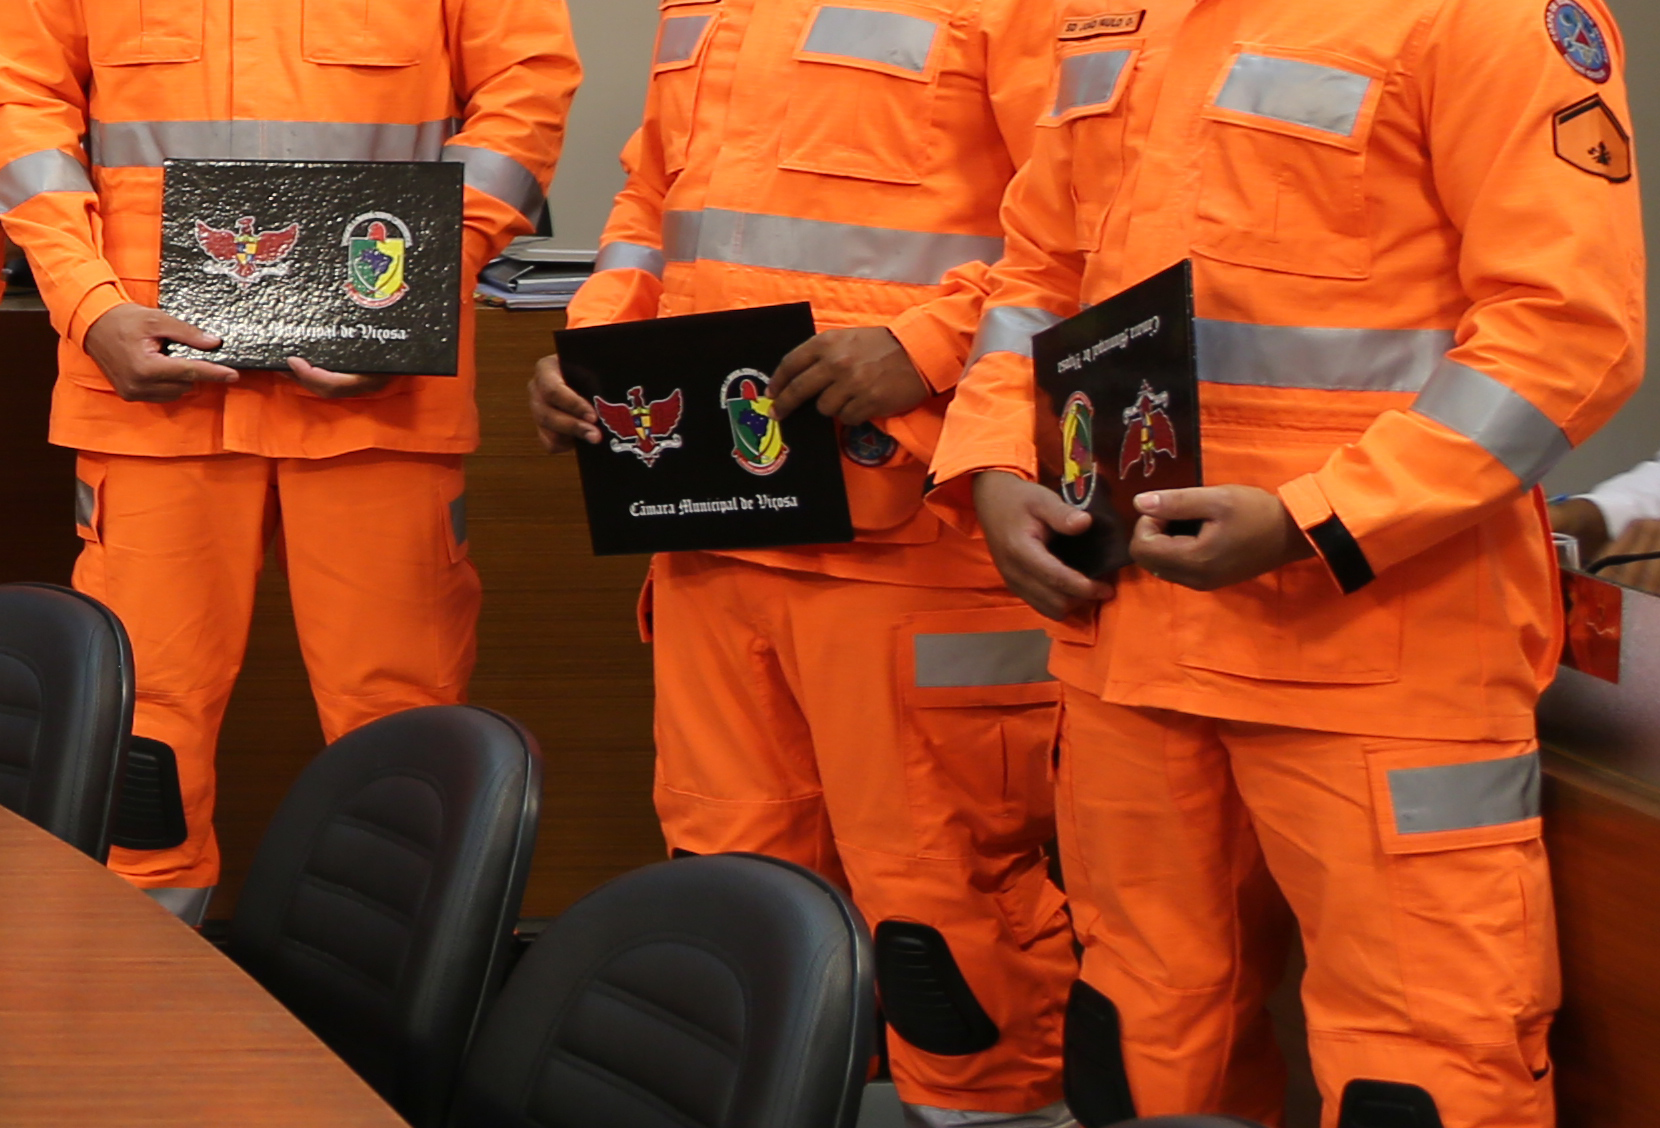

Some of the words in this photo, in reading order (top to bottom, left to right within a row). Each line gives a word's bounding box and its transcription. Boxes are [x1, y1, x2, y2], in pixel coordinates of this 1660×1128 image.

[340, 324, 357, 339] de
[357, 324, 406, 343] Viçosa
[629, 500, 676, 517] Câmara
[679, 497, 739, 515] Municipal
[739, 496, 754, 510] de
[755, 493, 799, 511] Viçosa
